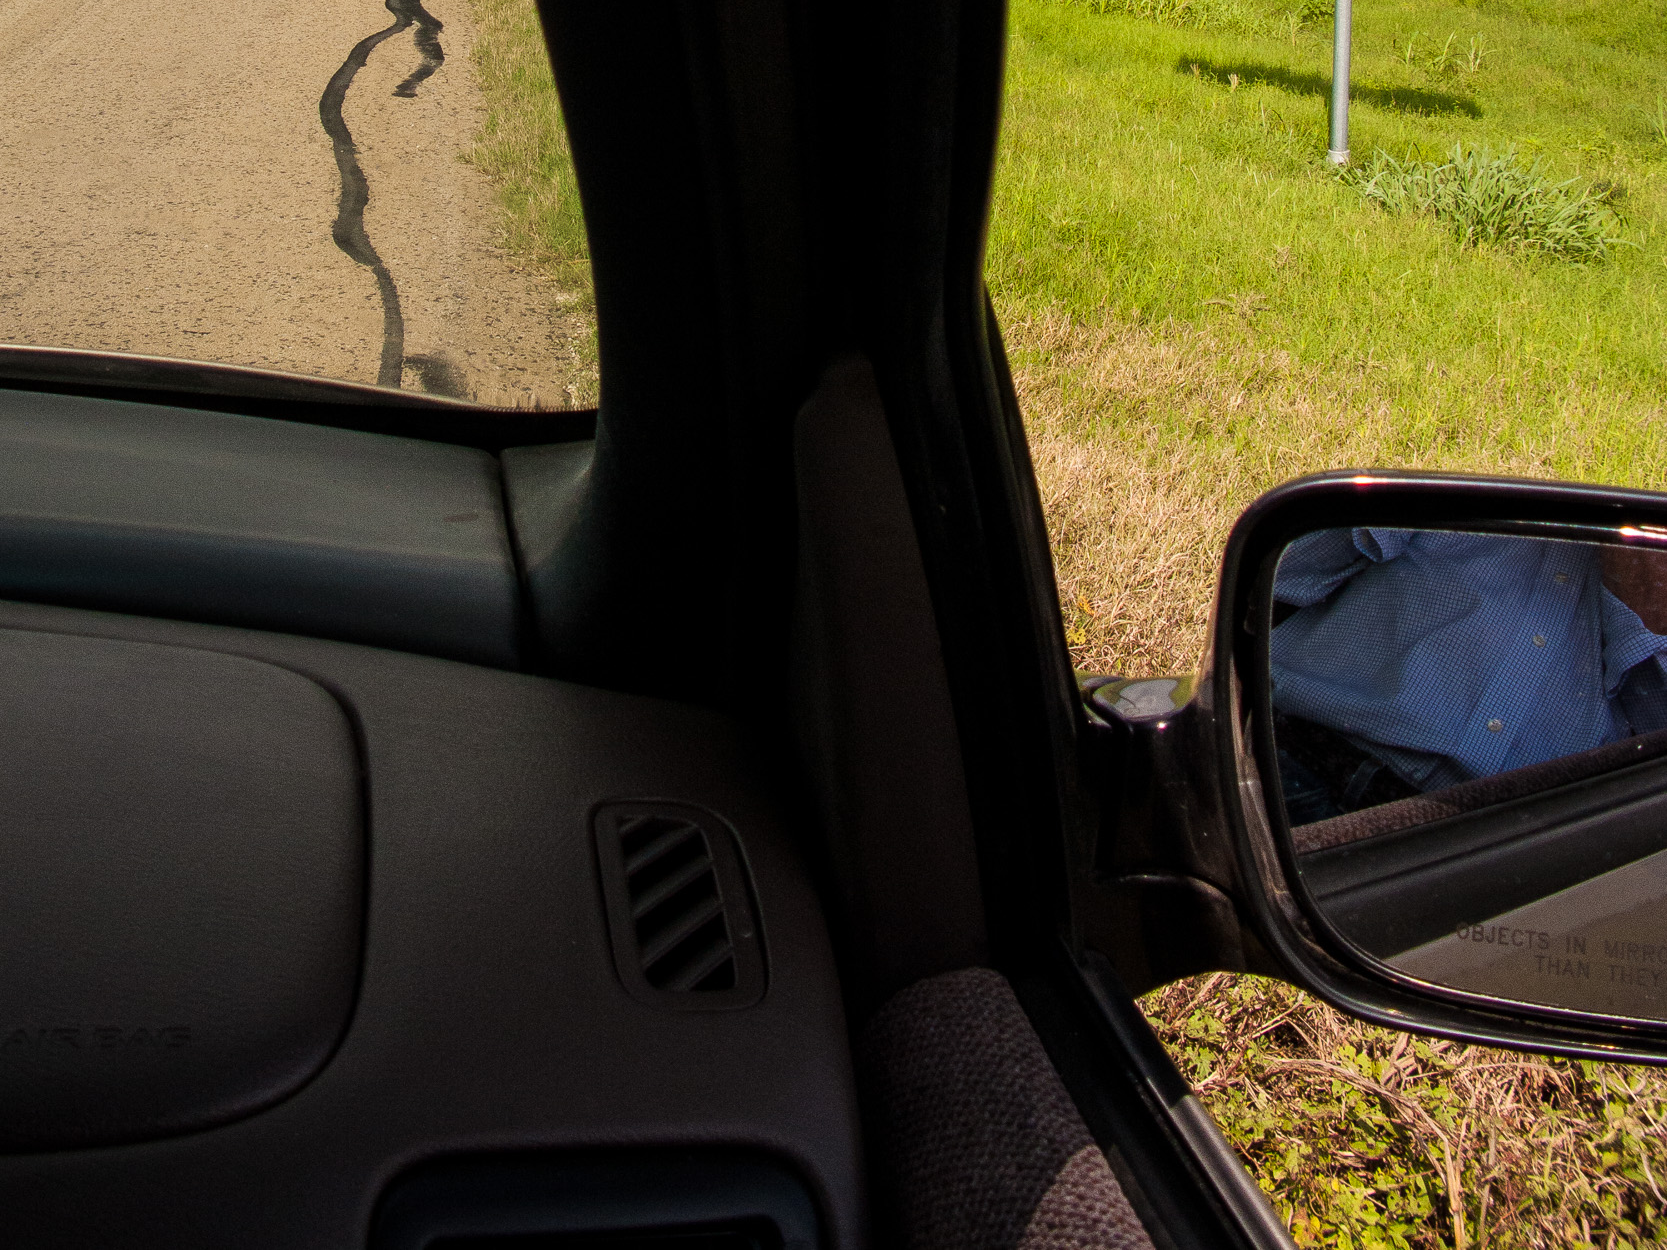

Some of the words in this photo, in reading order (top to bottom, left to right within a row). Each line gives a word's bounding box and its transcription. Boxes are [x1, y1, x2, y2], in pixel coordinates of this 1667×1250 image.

[1456, 921, 1550, 950] OBJECTS
[1566, 935, 1587, 955] IN
[1535, 955, 1590, 979] THAN
[1608, 964, 1664, 987] THEY
